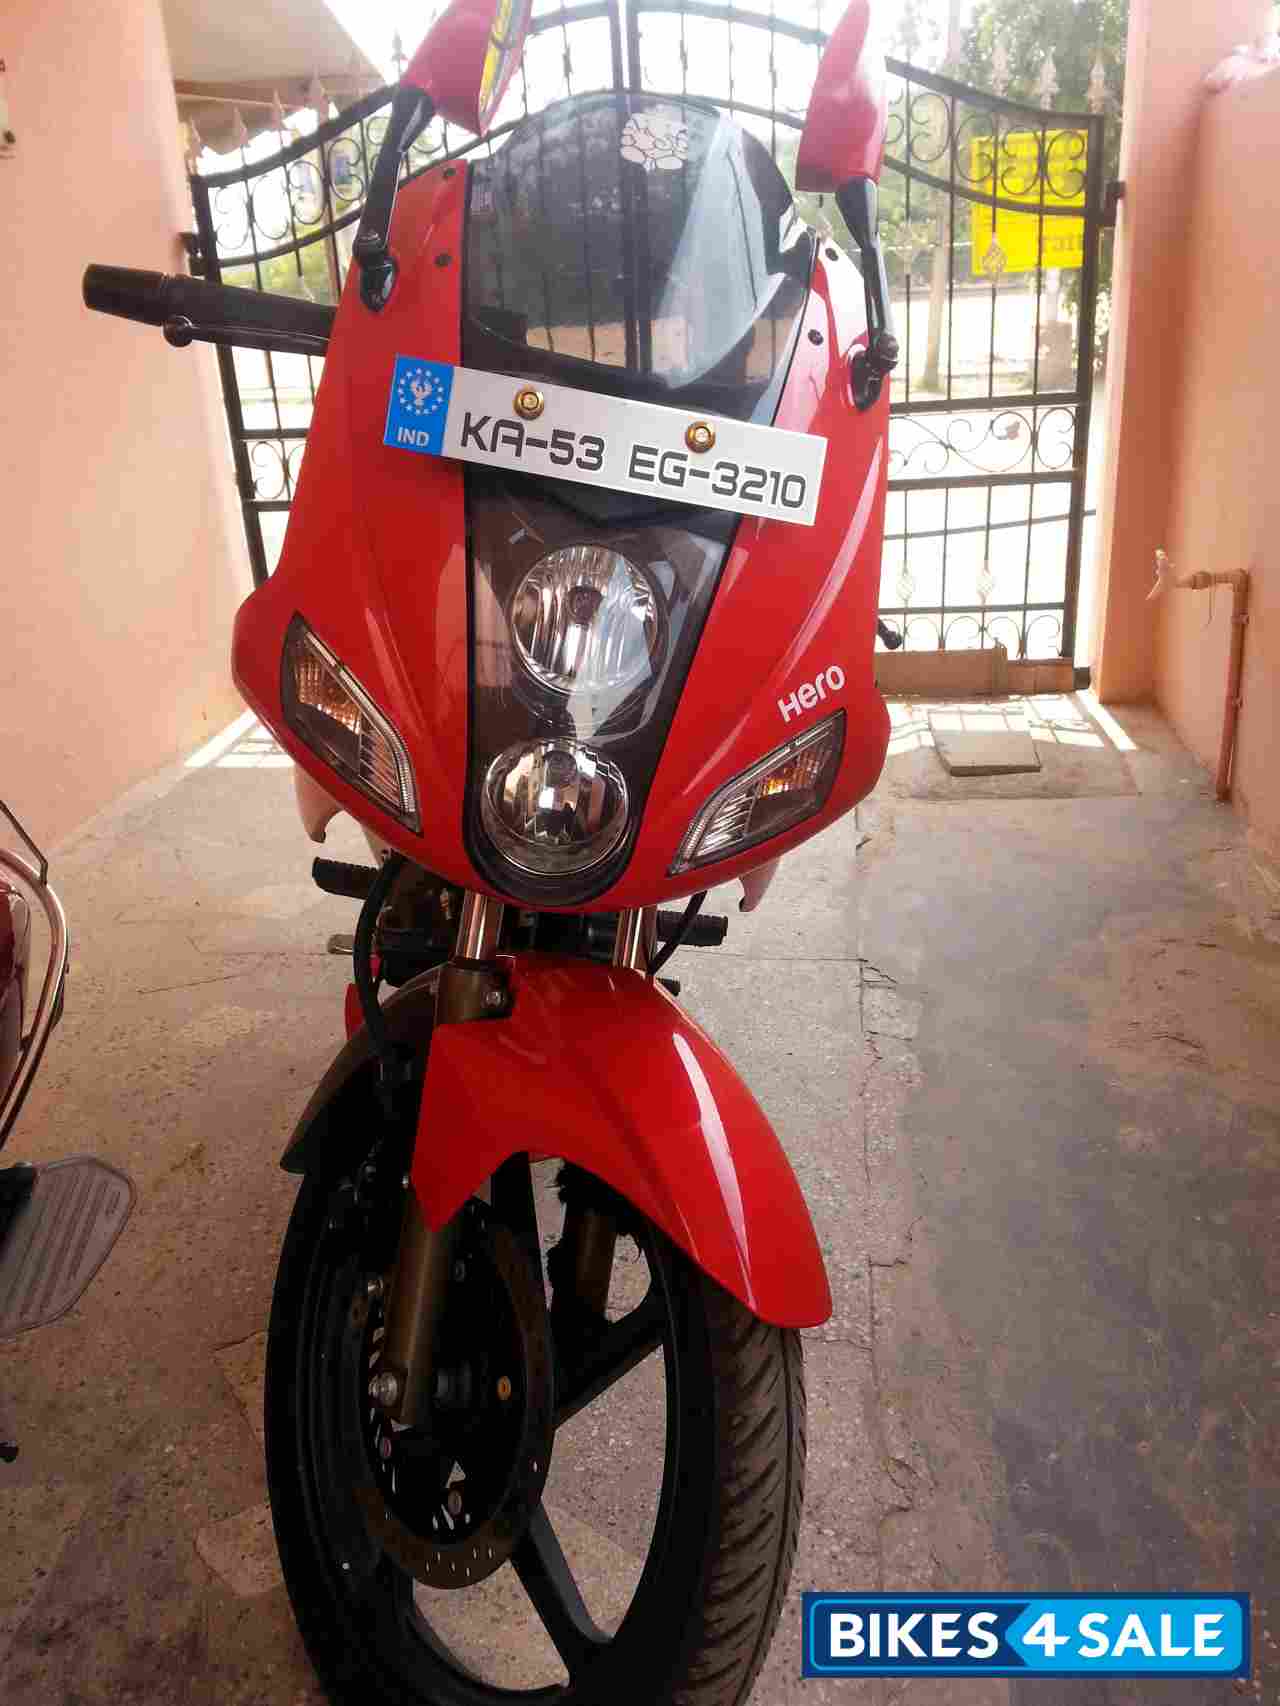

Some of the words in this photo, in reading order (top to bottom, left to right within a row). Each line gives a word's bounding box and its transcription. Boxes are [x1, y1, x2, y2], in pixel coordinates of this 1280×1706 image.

[398, 426, 430, 447] IND
[461, 412, 605, 471] KA-53
[629, 444, 806, 509] EG-3210
[777, 665, 845, 722] Hero
